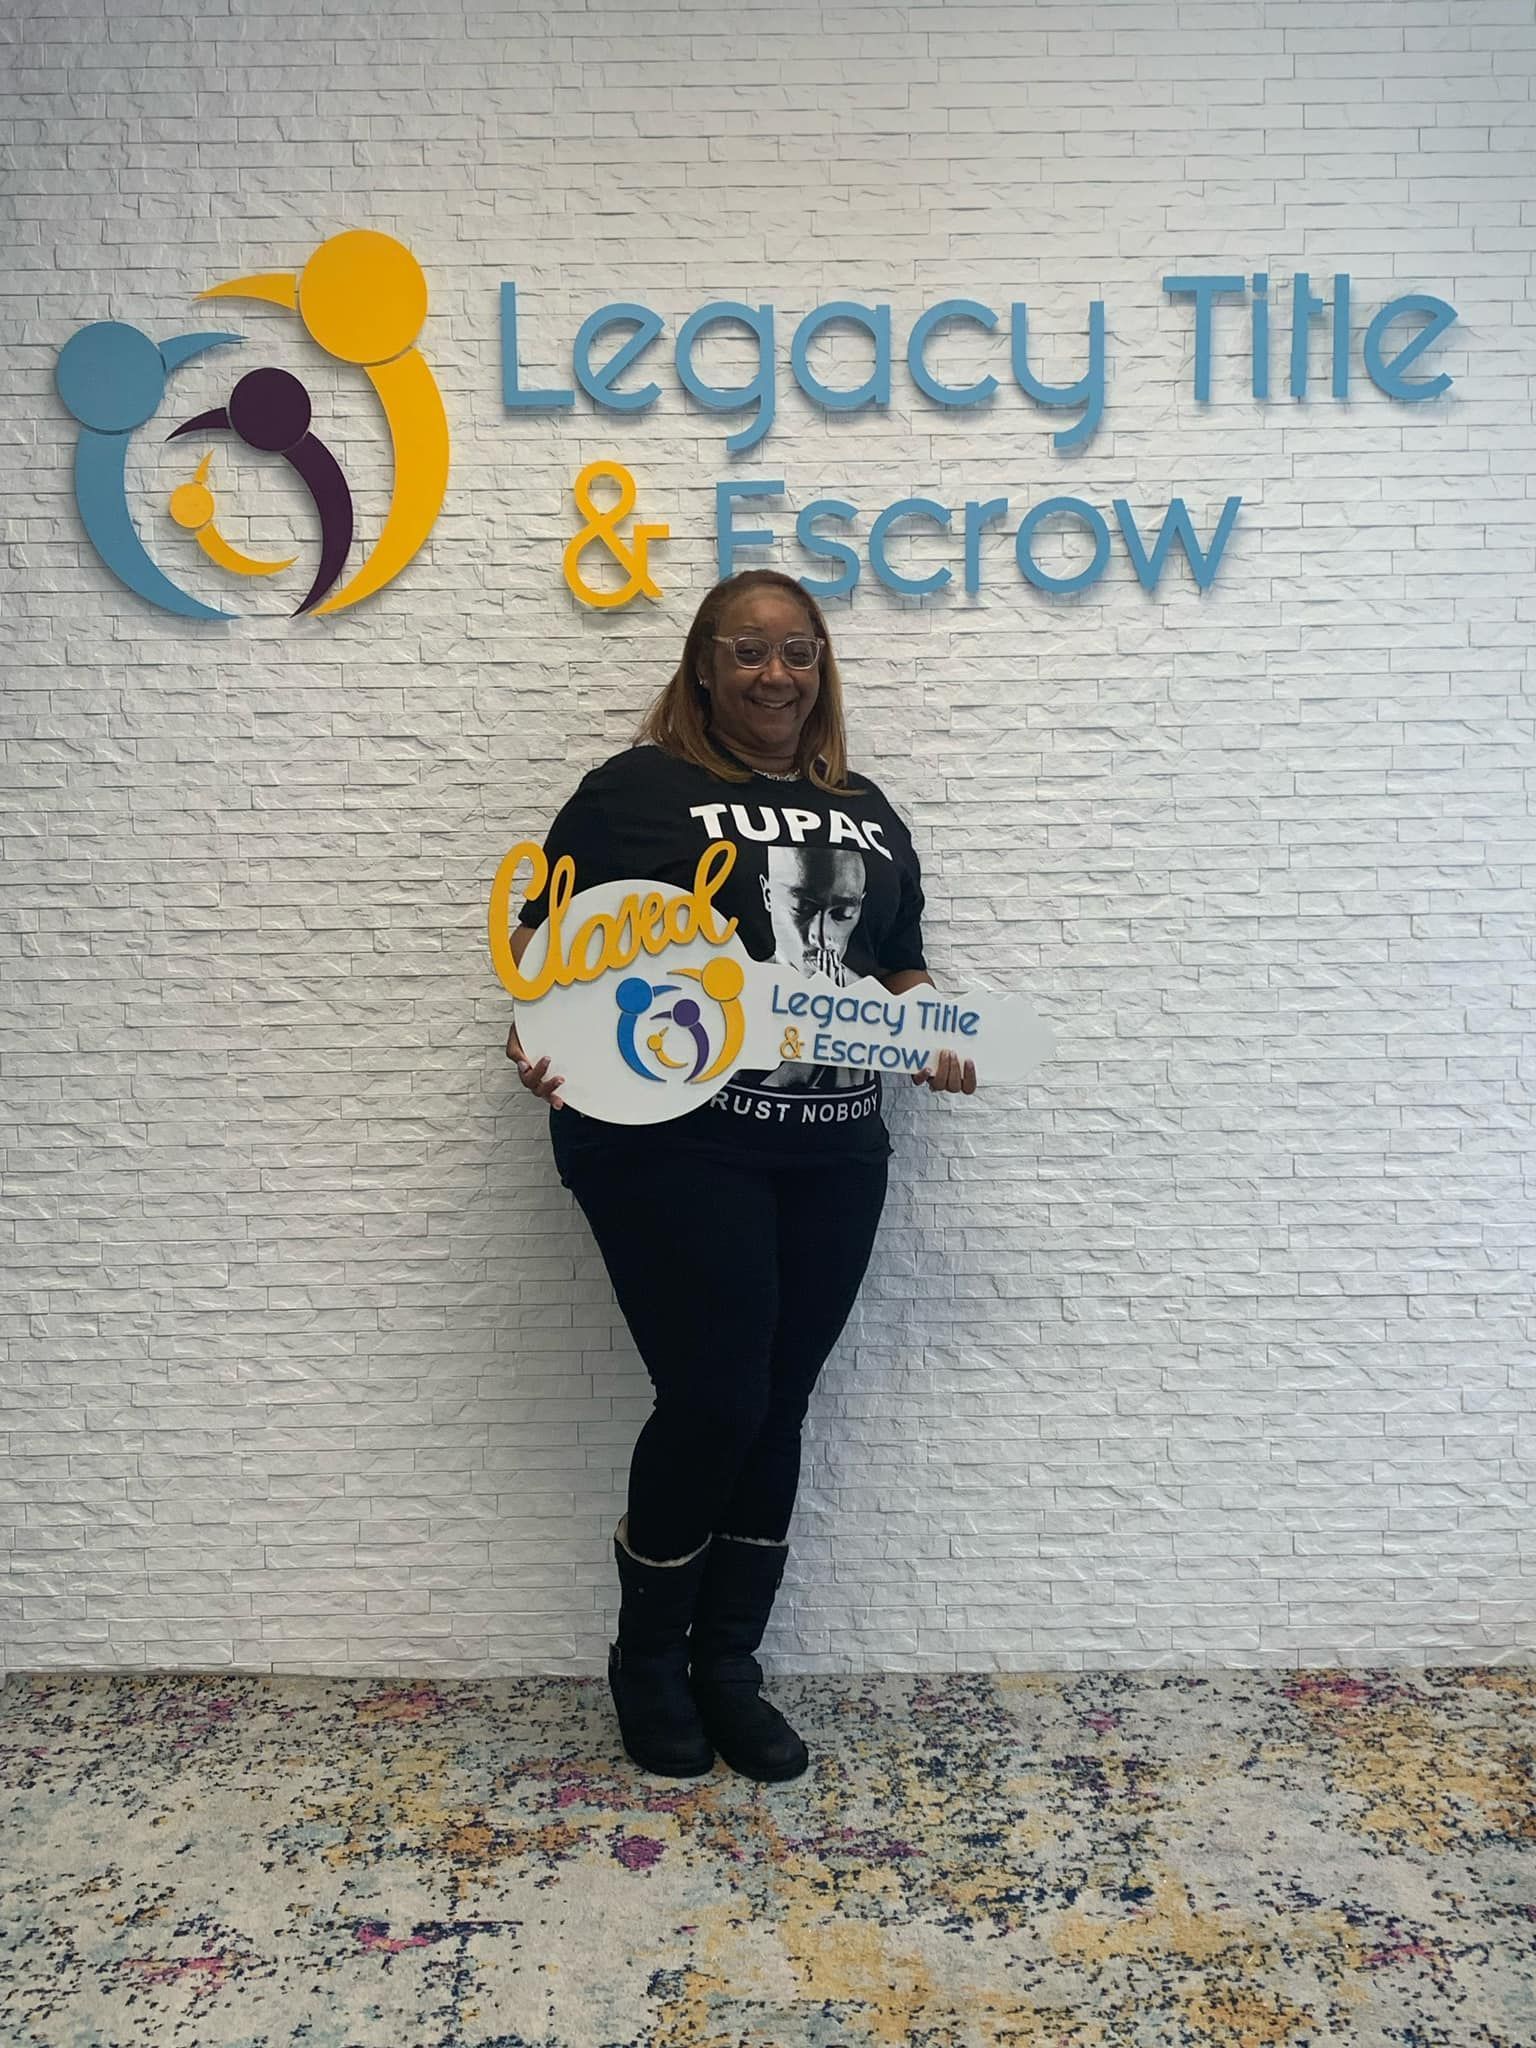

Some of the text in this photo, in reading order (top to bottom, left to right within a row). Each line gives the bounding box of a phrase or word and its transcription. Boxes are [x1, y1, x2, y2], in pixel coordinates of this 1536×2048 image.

[500, 272, 1459, 452] Legacy Title
[563, 459, 1243, 608] & Escrow
[689, 803, 893, 861] TUPAC
[487, 840, 739, 1001] Closed
[771, 984, 980, 1036] Legacy Title
[780, 1025, 930, 1069] & Escrow
[710, 1089, 878, 1124] RUST NOBODY
